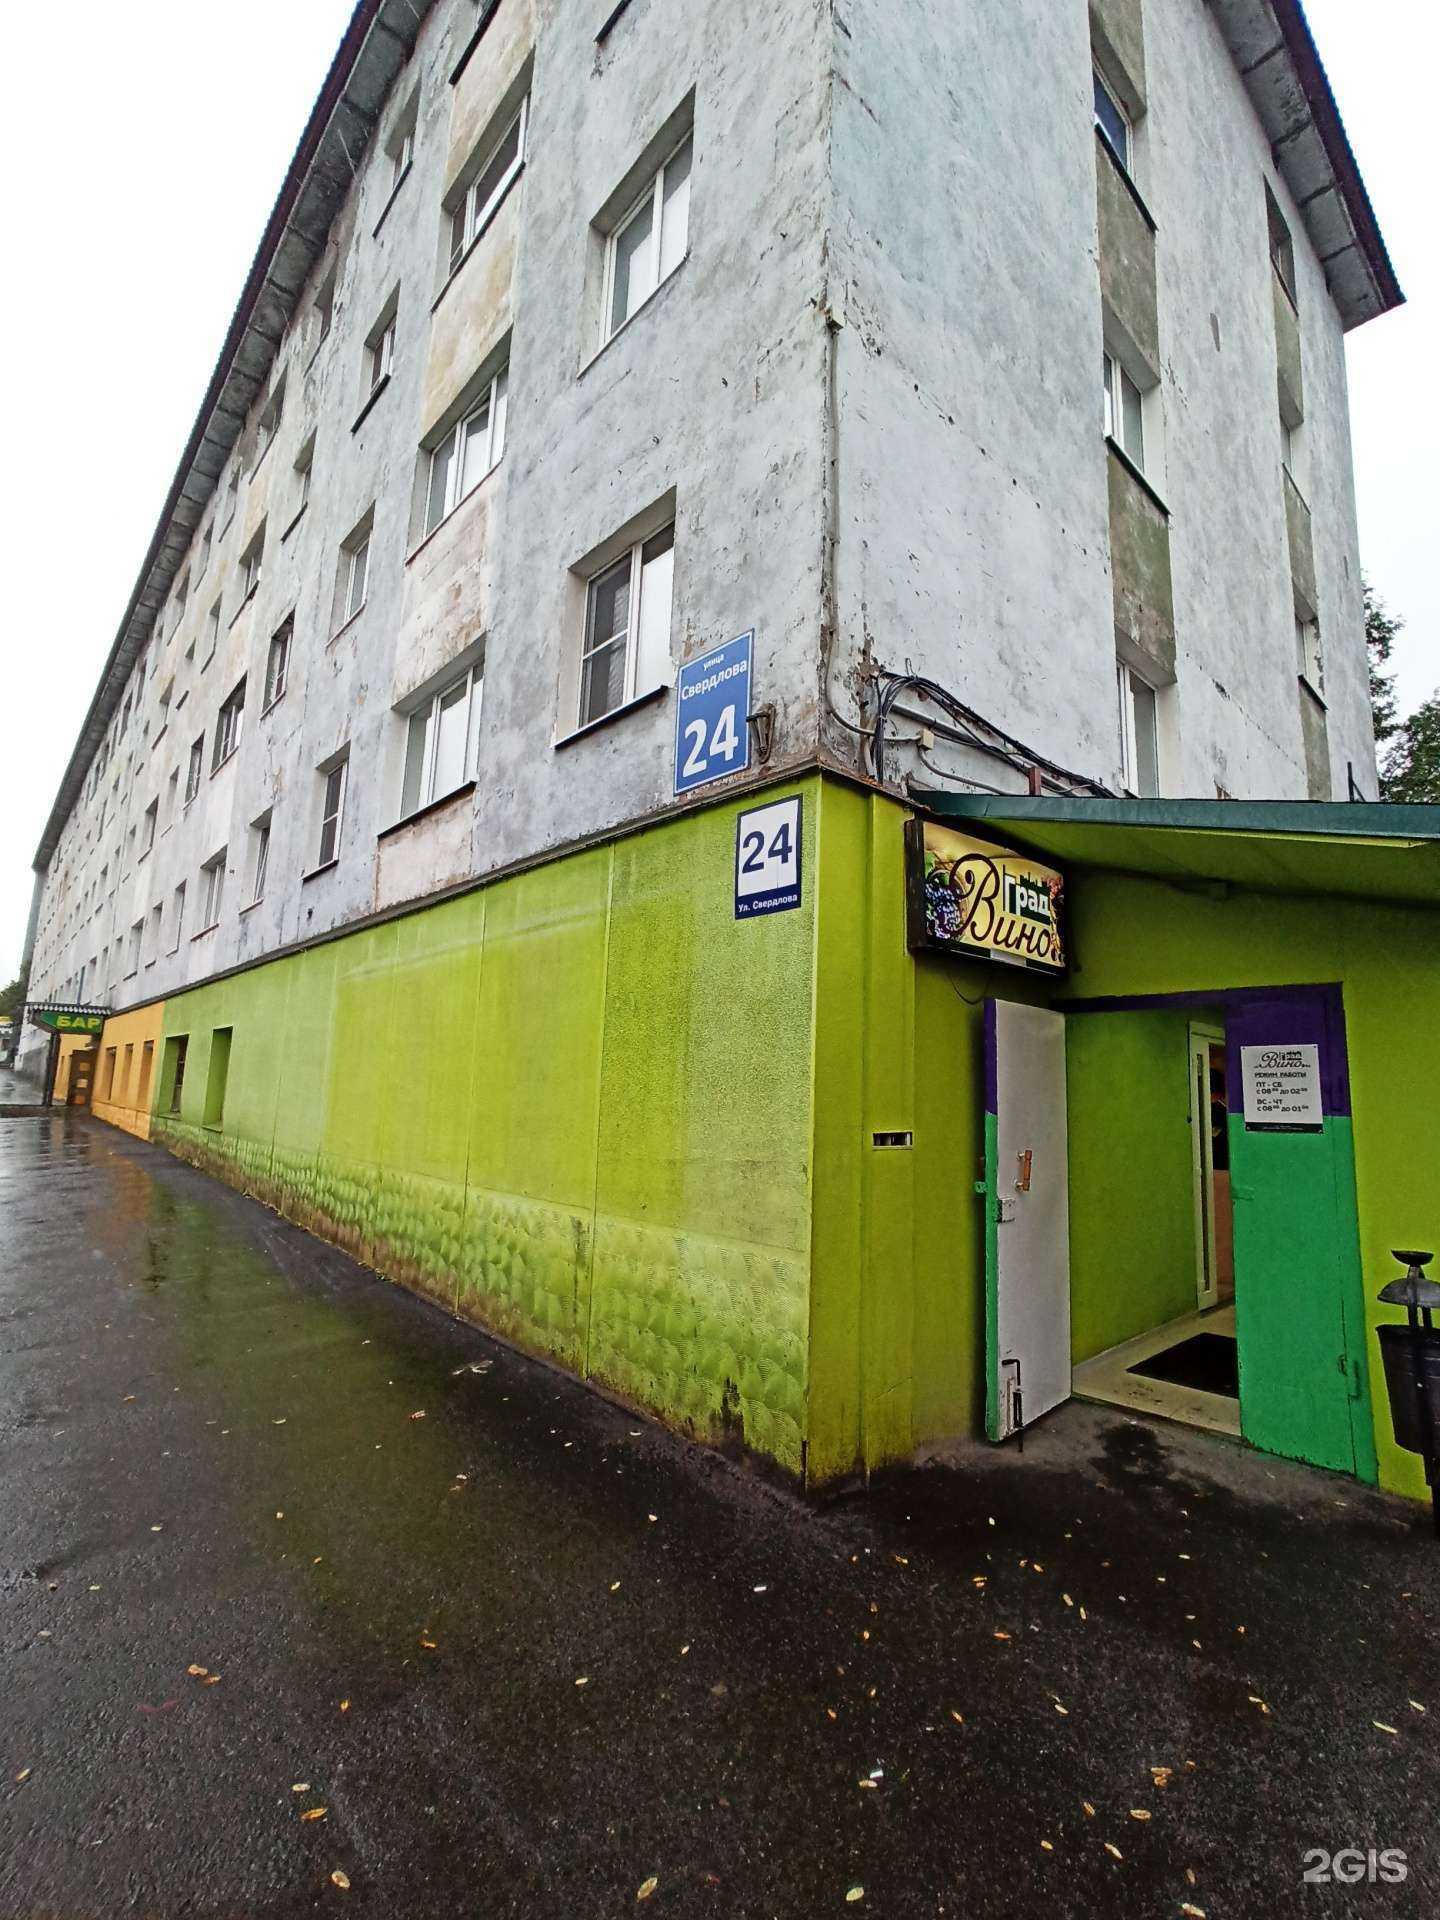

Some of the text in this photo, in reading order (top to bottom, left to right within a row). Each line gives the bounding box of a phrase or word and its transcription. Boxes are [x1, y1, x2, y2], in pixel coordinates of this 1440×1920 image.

[681, 659, 748, 700] Свердлова
[703, 653, 725, 671] улица
[682, 703, 739, 778] 24
[741, 822, 793, 874] 24
[738, 893, 798, 913] Ул. Свердлова
[950, 853, 1051, 957] Вино
[1003, 873, 1050, 917] Град
[56, 1015, 101, 1029] БАР
